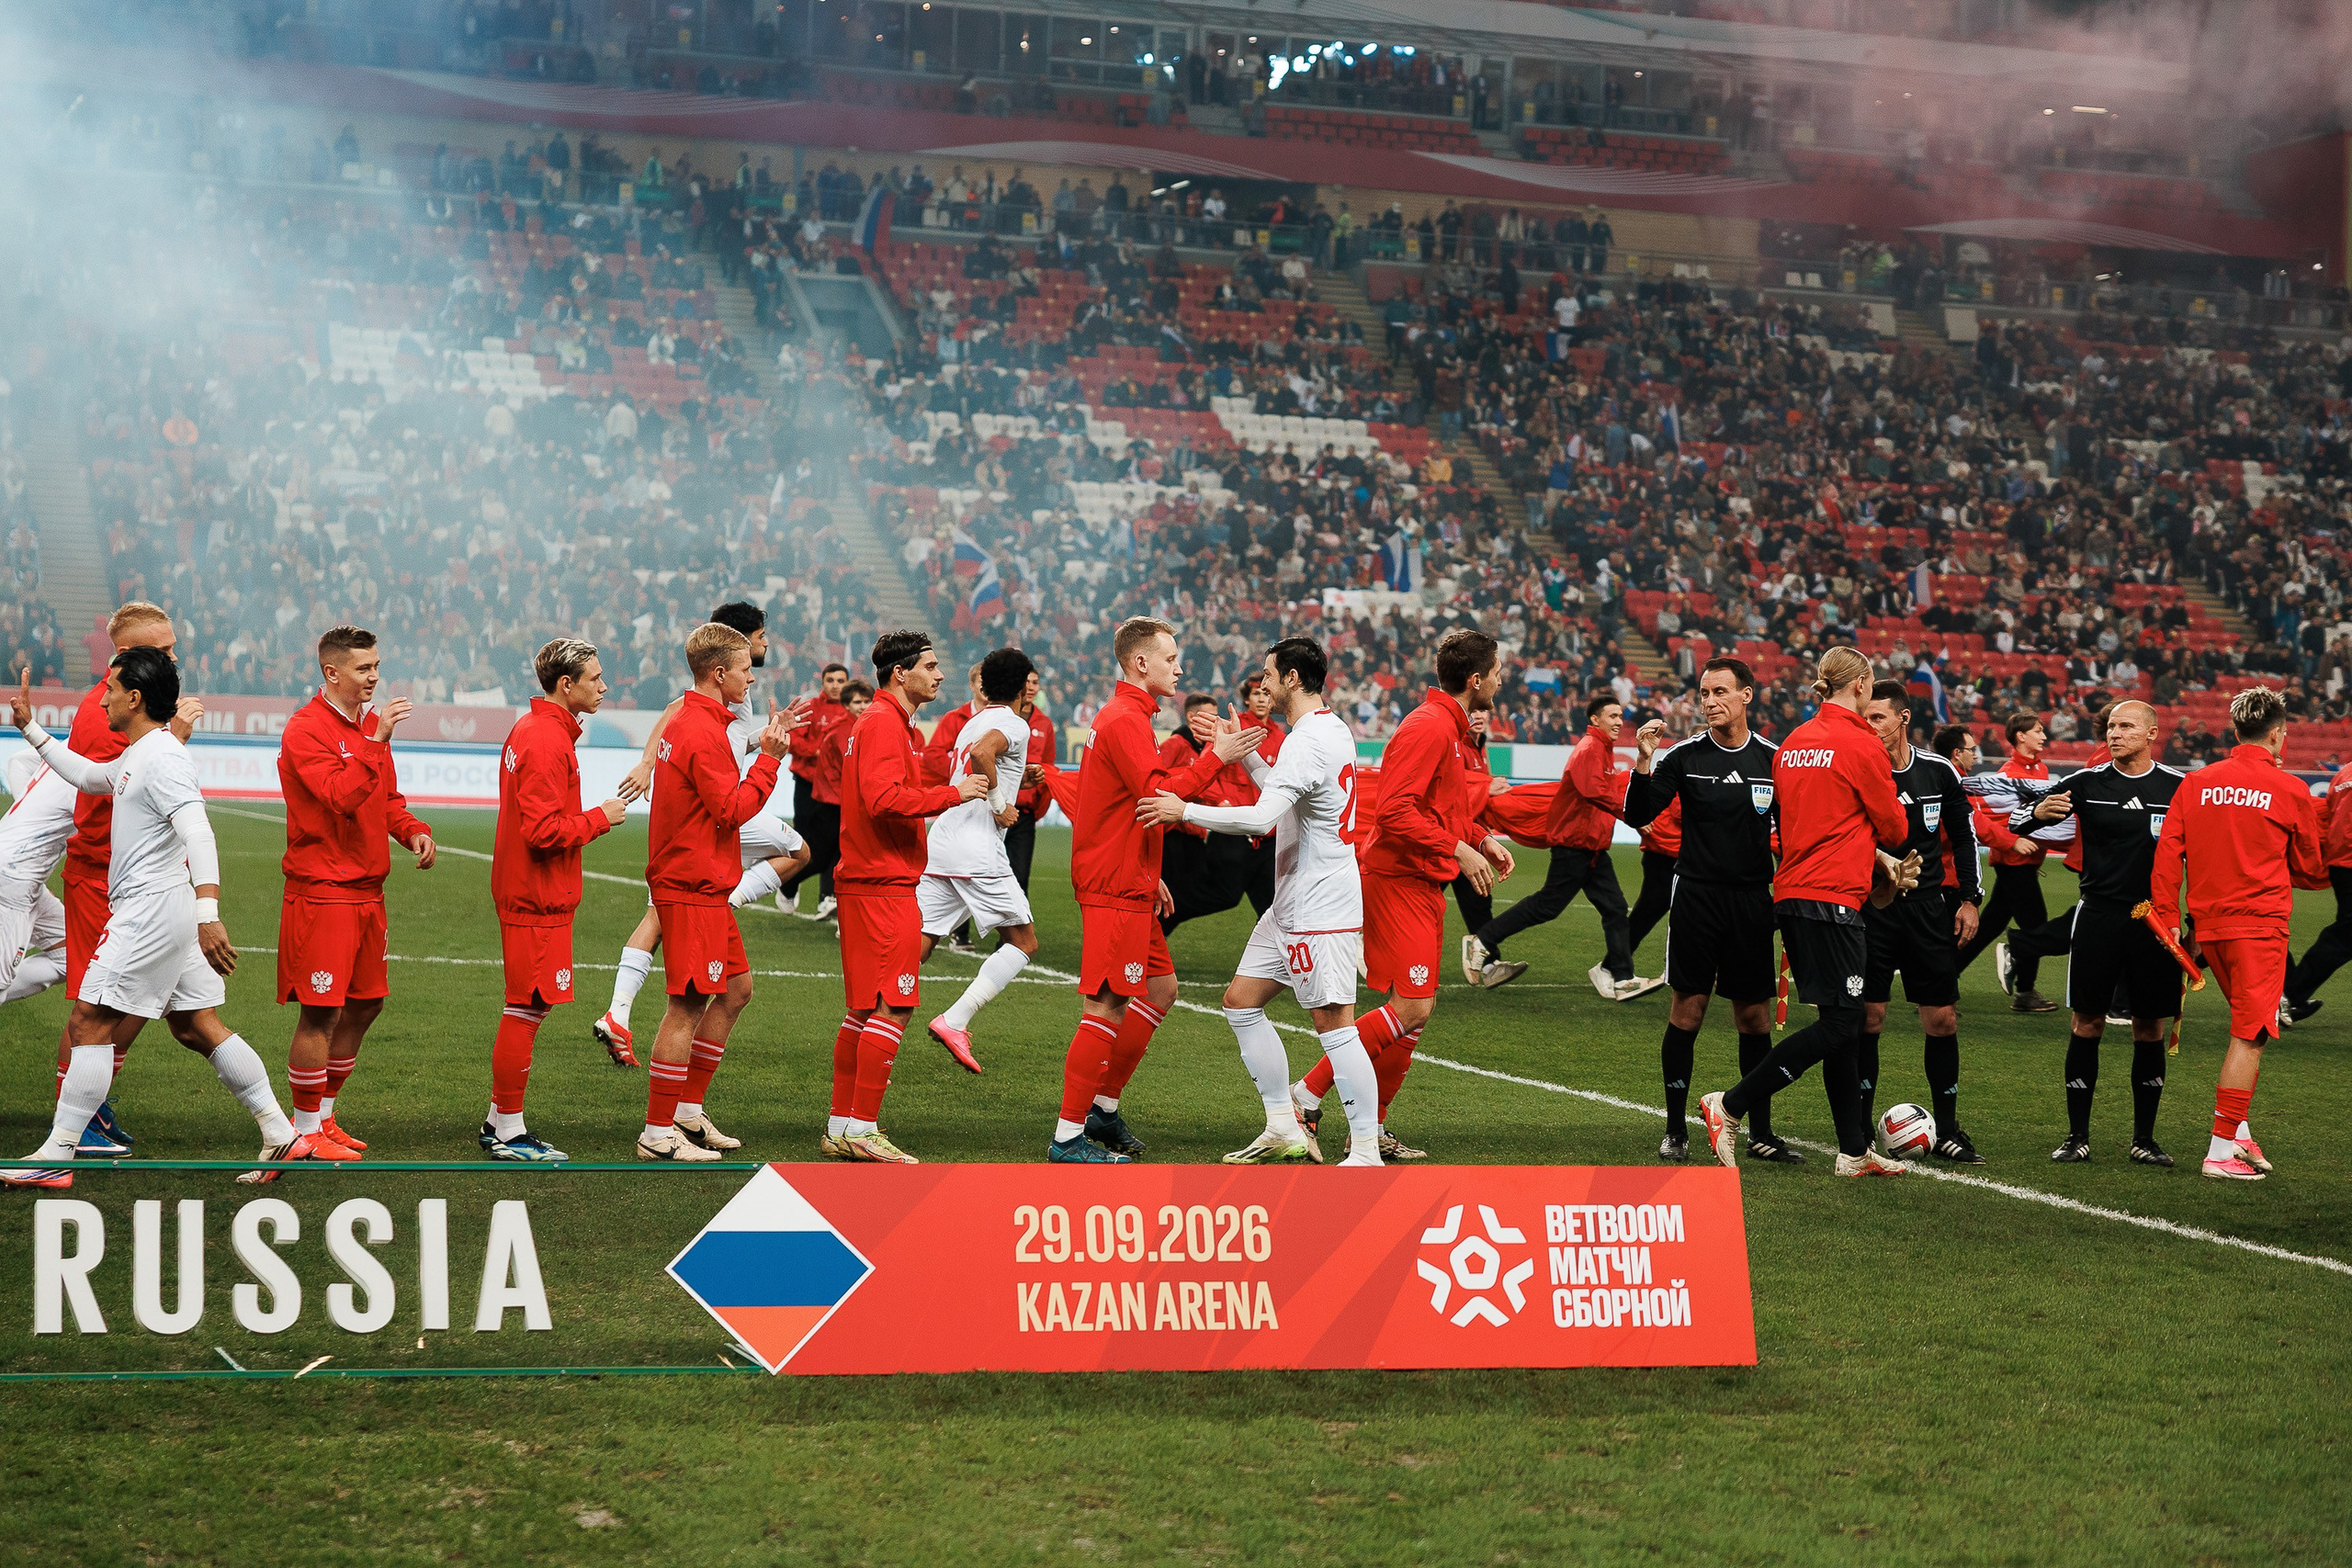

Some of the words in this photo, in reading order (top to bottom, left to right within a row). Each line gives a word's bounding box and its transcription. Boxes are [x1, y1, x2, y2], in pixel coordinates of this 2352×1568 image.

[1780, 749, 1836, 769] РОССИЯ
[1754, 786, 1771, 795] FIFA
[1925, 805, 1939, 813] FIFA
[2200, 785, 2272, 811] РОССИЯ
[1287, 942, 1314, 975] 20
[1013, 1204, 1272, 1263] 29.09.2026
[1544, 1203, 1686, 1244] BETBOOM
[33, 1197, 554, 1335] RUSSIA
[1547, 1246, 1653, 1285] МАТЧИ
[1016, 1281, 1148, 1332] KAZAN
[1153, 1280, 1280, 1331] ARENA
[1552, 1278, 1692, 1328] СБОРНОЙ
